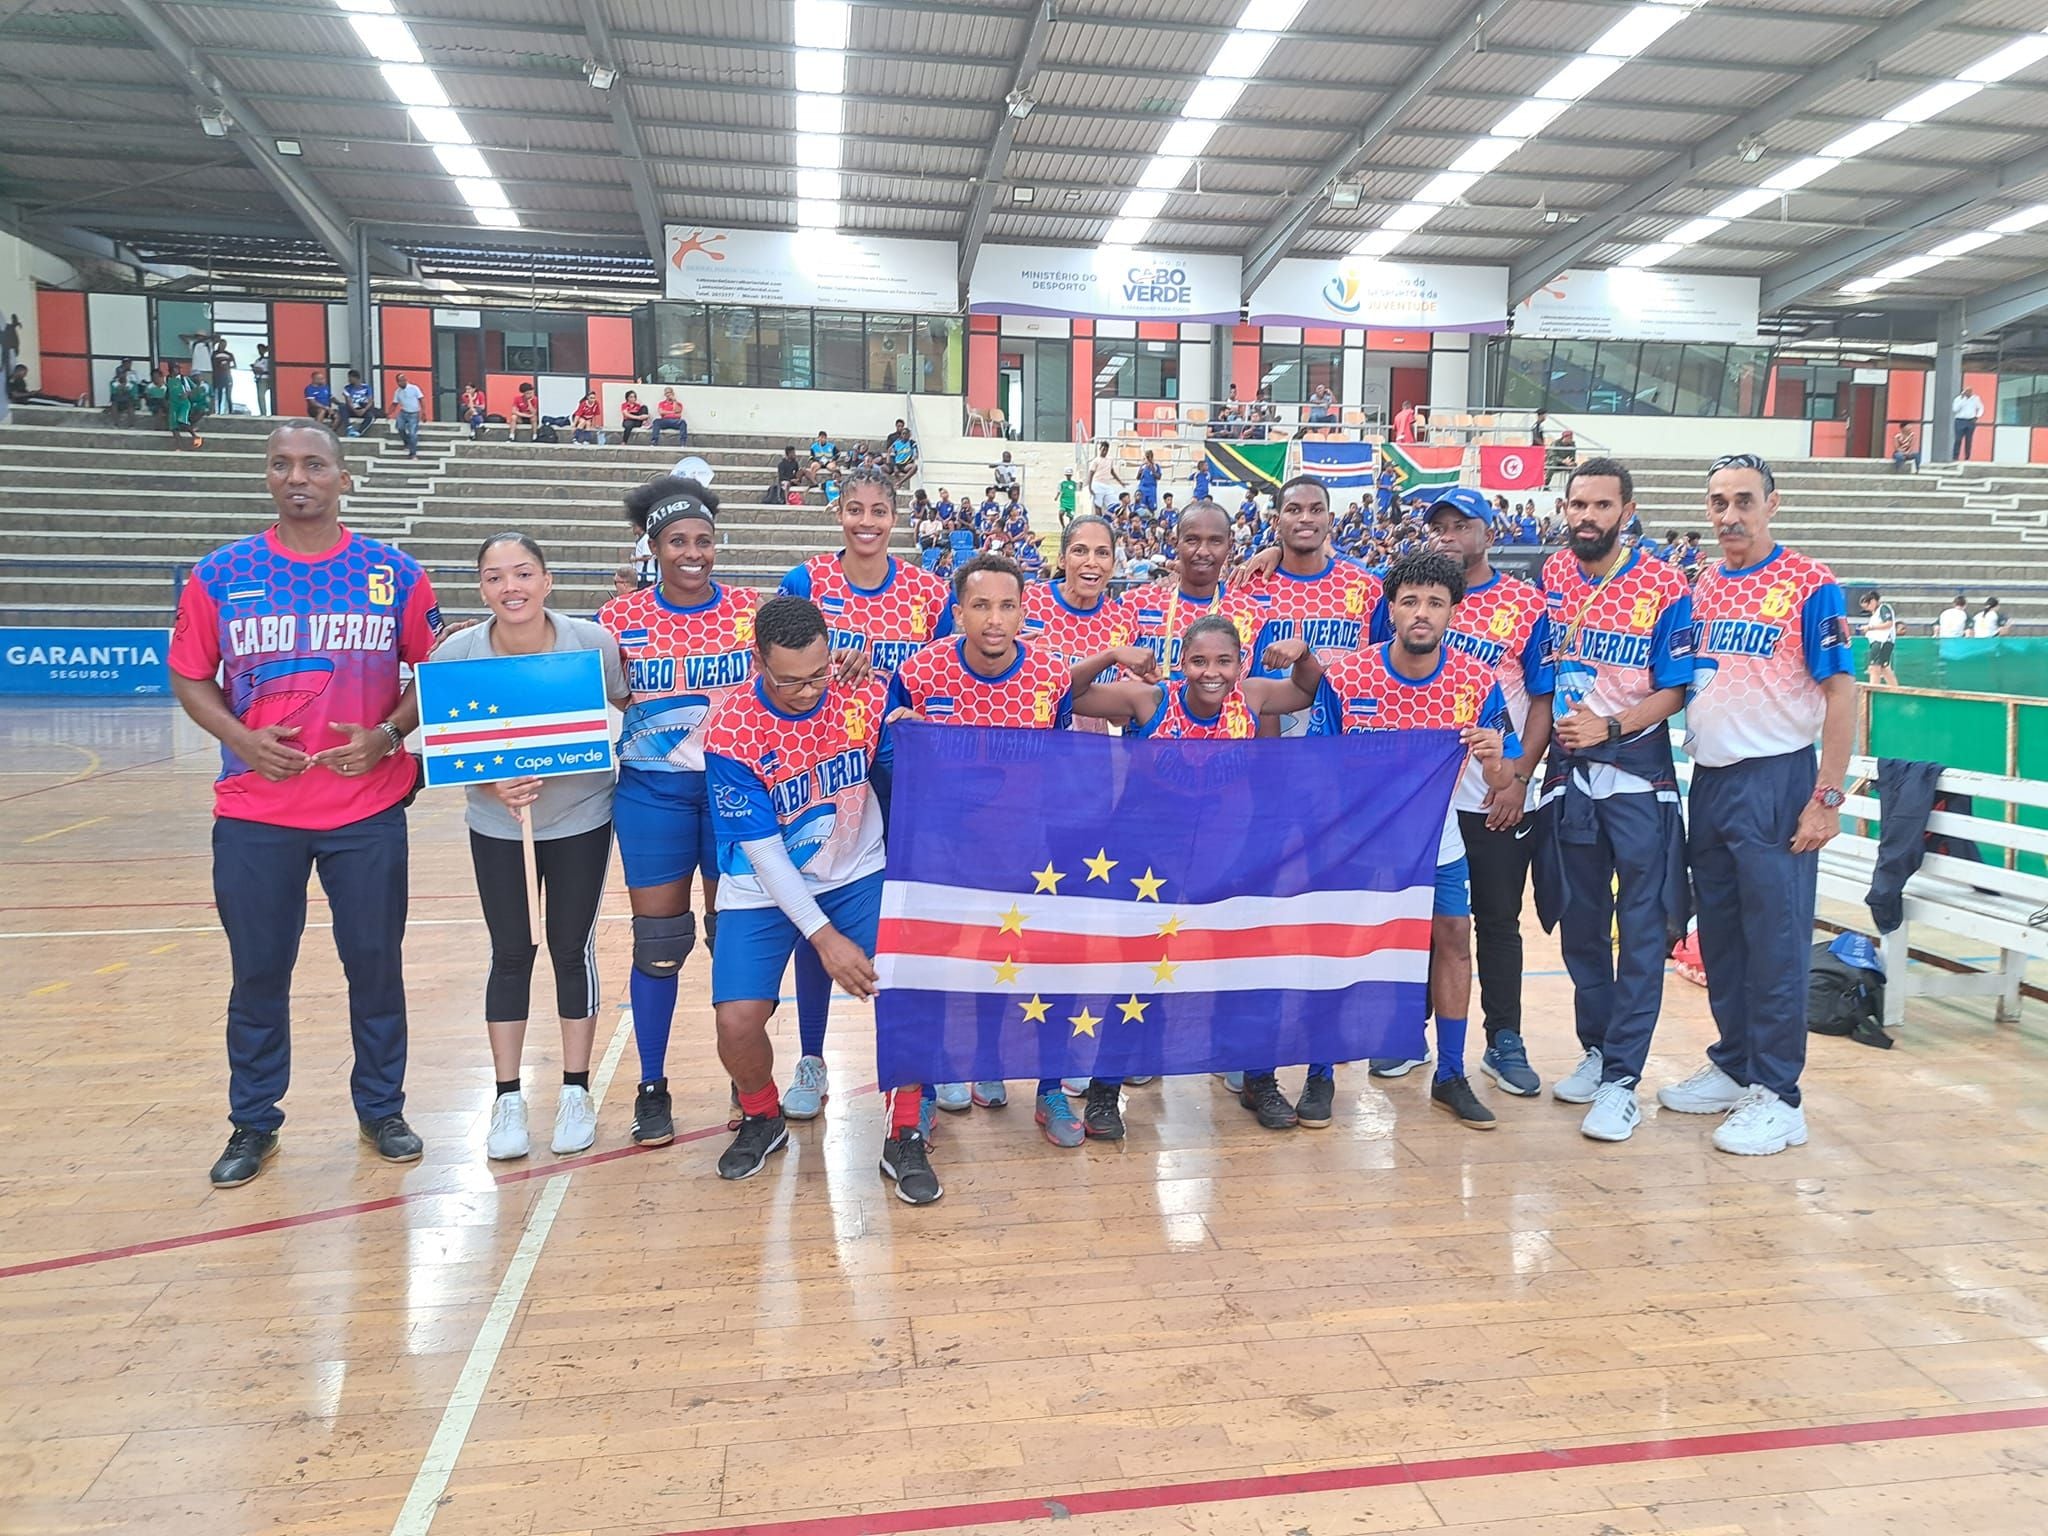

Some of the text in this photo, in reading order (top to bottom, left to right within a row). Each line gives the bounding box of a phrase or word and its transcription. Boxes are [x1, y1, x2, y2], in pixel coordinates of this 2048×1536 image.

[1021, 269, 1098, 282] MINISTÉRIO DO
[1032, 280, 1087, 292] DESPORTO
[1128, 267, 1186, 285] CABO
[1123, 285, 1192, 304] VERDE
[229, 615, 296, 656] CABO
[308, 613, 396, 652] VERDE
[1269, 618, 1361, 651] BO VERDE
[1708, 619, 1783, 660] VERDE
[6, 646, 160, 666] GARANTIA
[1580, 626, 1652, 669] VERDE
[50, 670, 120, 680] SEGUROS
[514, 748, 603, 771] Cape Verde
[769, 769, 812, 817] ABO
